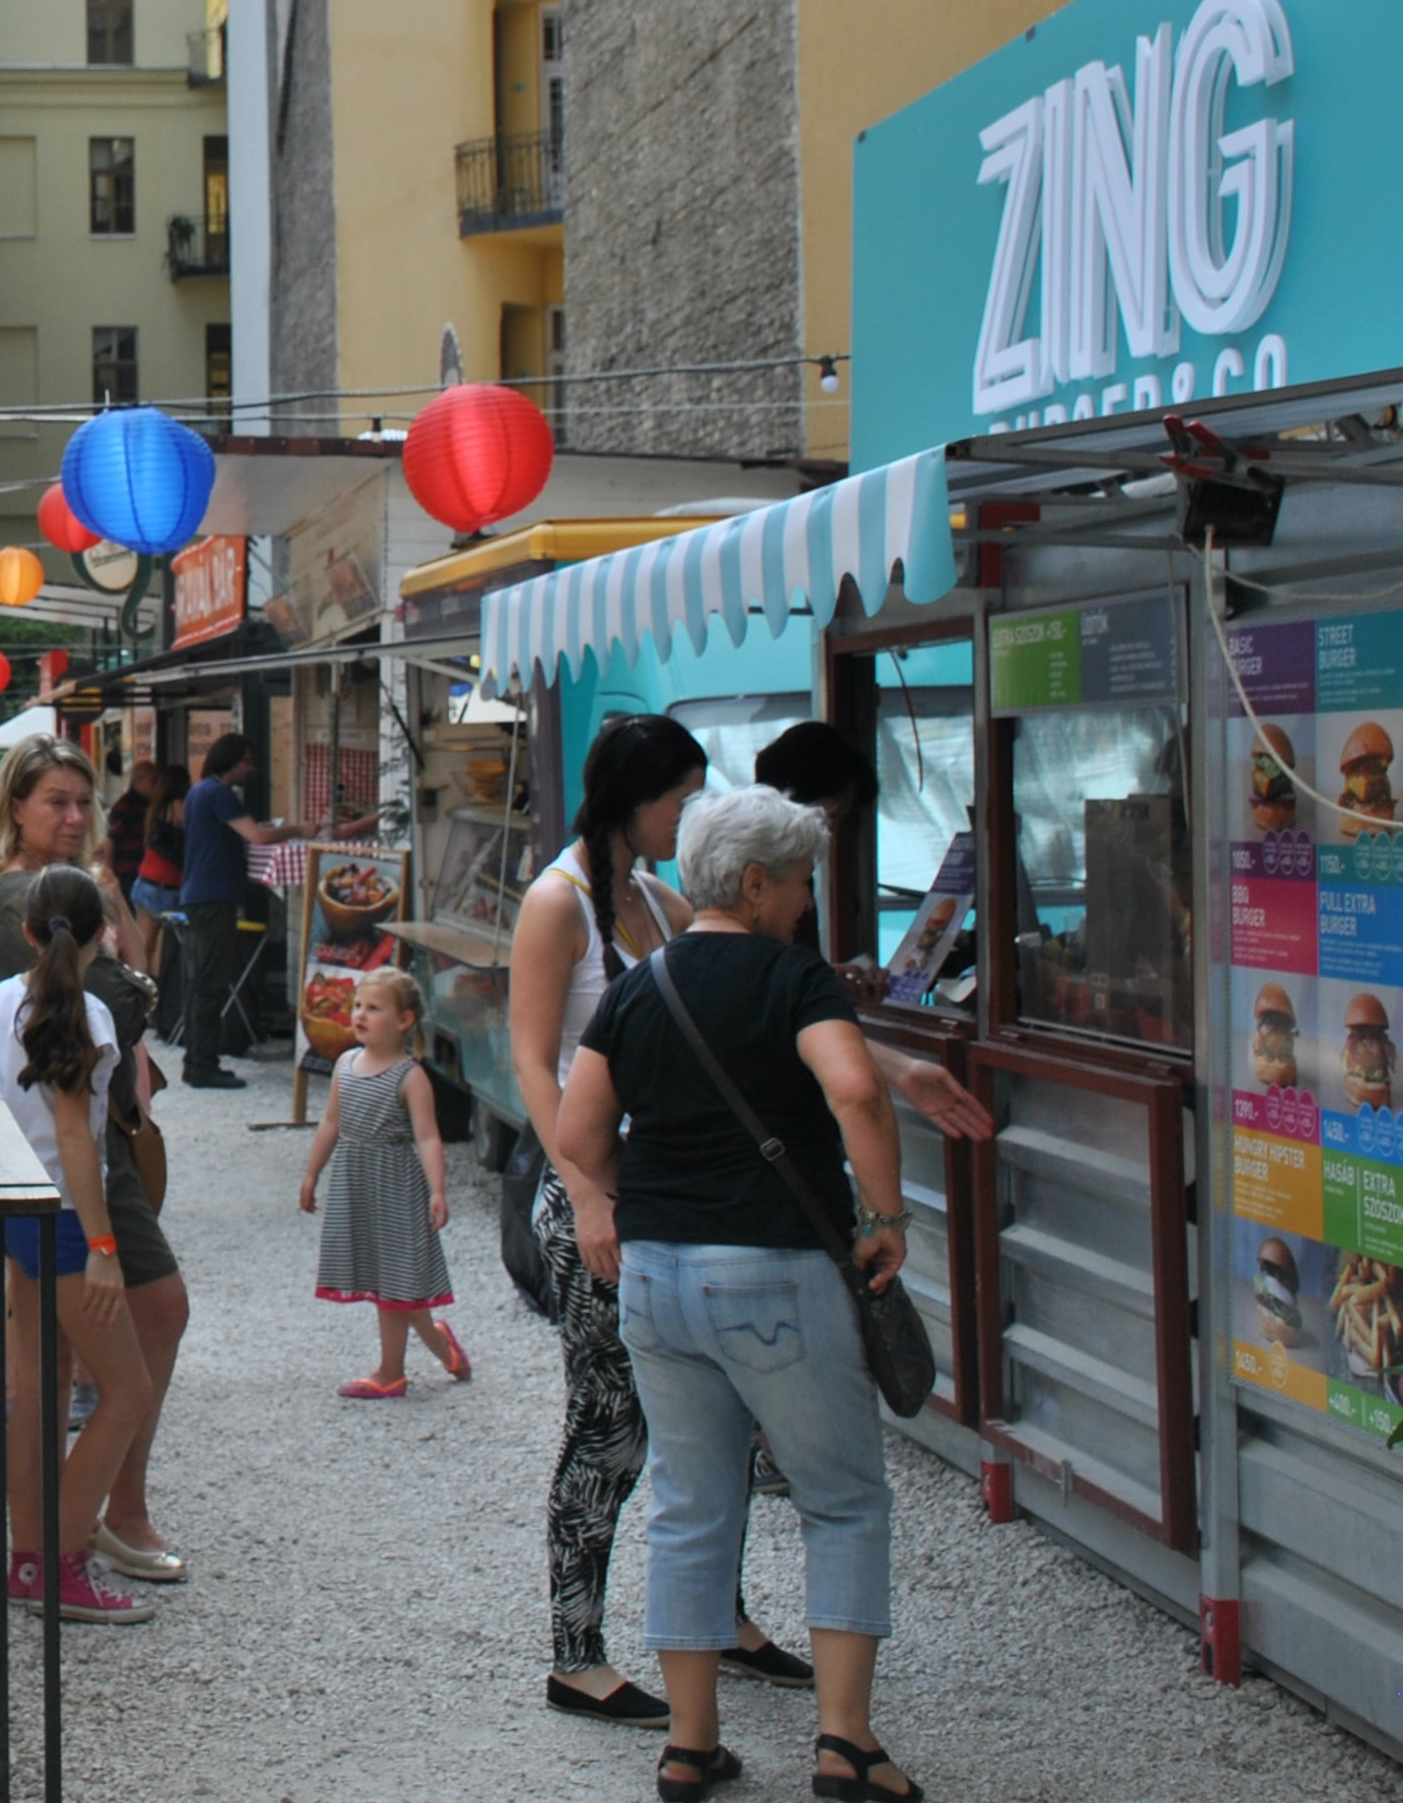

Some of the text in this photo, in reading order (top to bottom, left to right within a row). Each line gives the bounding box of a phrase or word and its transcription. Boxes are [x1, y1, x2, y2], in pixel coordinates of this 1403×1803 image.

[973, 0, 1294, 415] ZING
[1318, 624, 1354, 646] STREET
[1318, 647, 1357, 670] BURGER
[1319, 891, 1377, 915] FULL EXTRA
[1232, 906, 1266, 928] BURGER
[1319, 914, 1358, 937] BURGER
[1234, 1133, 1306, 1170] HUNGRY HIPSTER
[1234, 1156, 1269, 1182] BURGER
[1323, 1157, 1355, 1186] HASÁB
[1363, 1169, 1396, 1197] EXTRA
